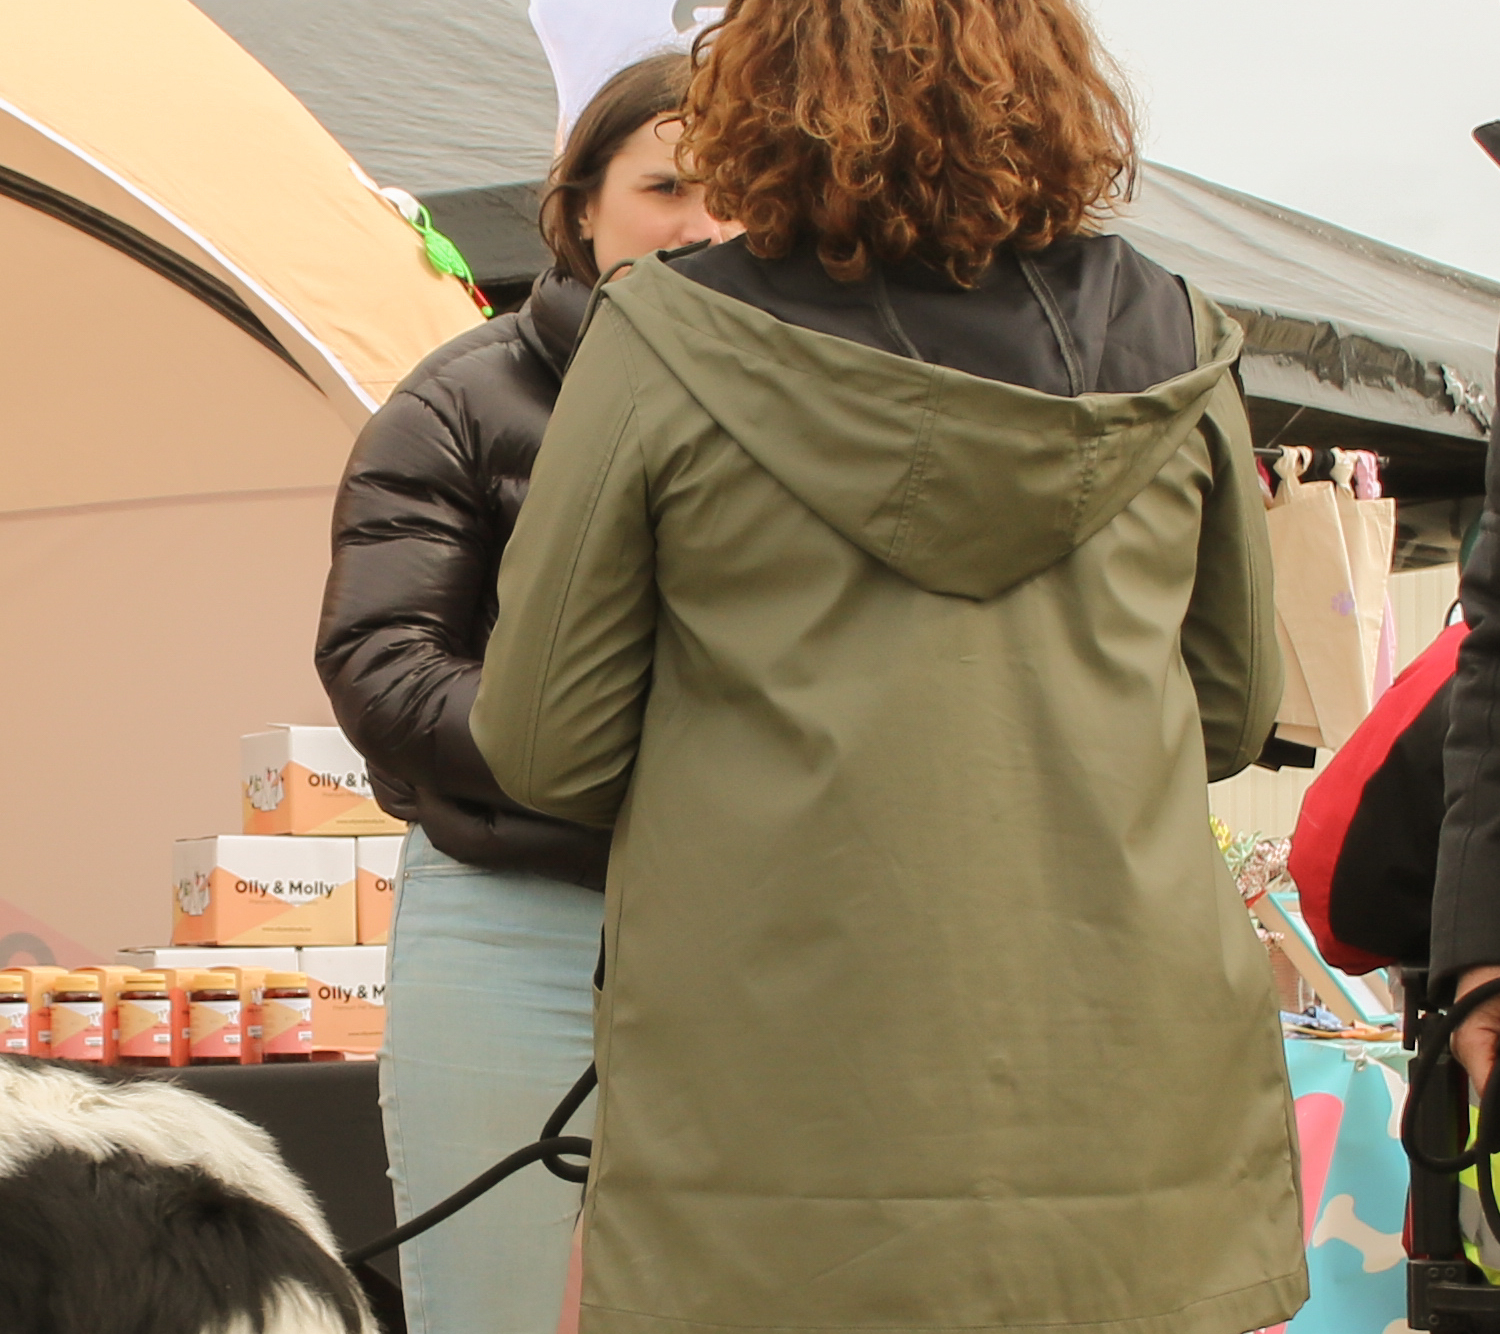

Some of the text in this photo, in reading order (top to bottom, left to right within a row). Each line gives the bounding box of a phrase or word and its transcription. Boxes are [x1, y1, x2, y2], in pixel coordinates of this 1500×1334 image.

[308, 772, 341, 791] Olly
[345, 772, 357, 787] &
[235, 880, 335, 899] Olly & Molly
[318, 985, 353, 1003] Olly
[357, 985, 368, 999] &
